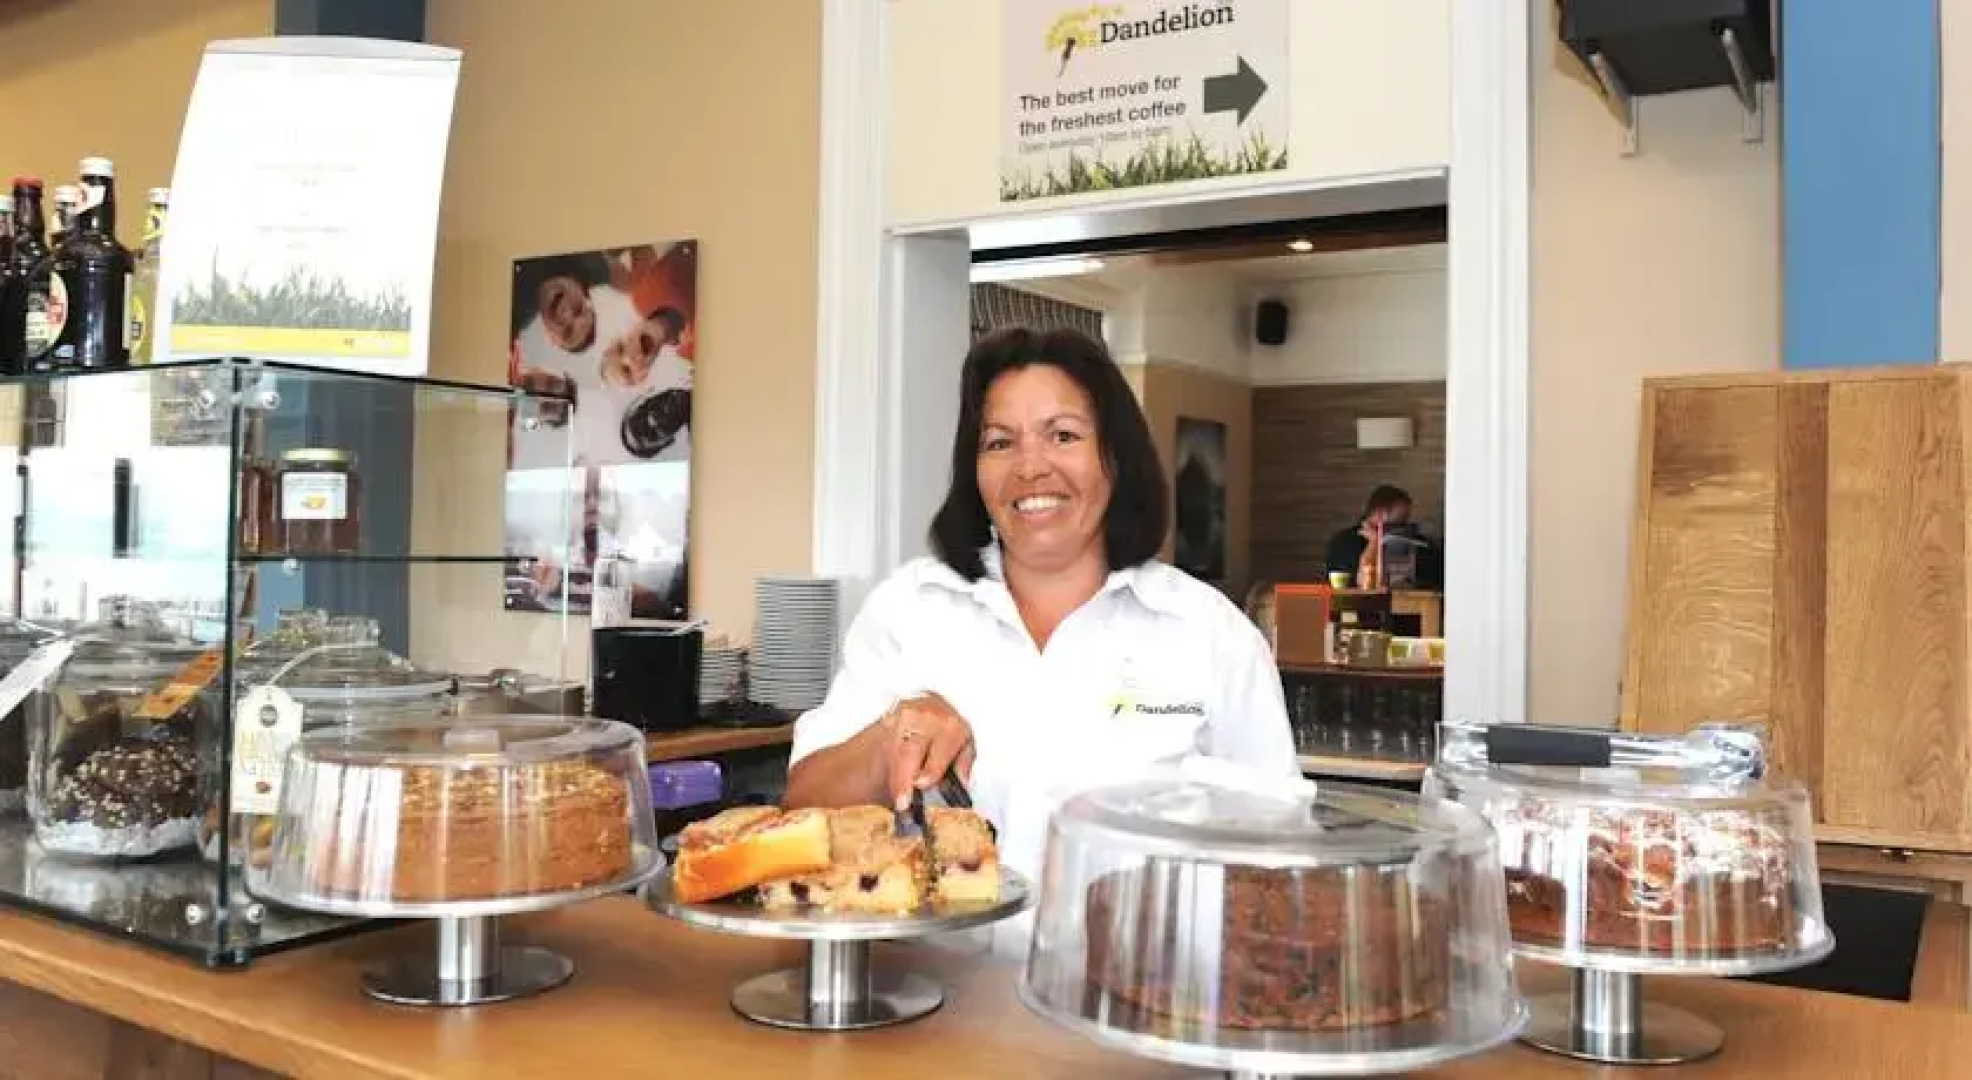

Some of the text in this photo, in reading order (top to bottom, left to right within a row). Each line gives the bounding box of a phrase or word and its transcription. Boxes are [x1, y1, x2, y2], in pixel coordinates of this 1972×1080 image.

[1100, 4, 1235, 43] Dandelion
[1019, 75, 1182, 111] The best move for
[1019, 120, 1046, 137] the
[1051, 107, 1123, 132] freshest
[1128, 100, 1187, 122] coffee
